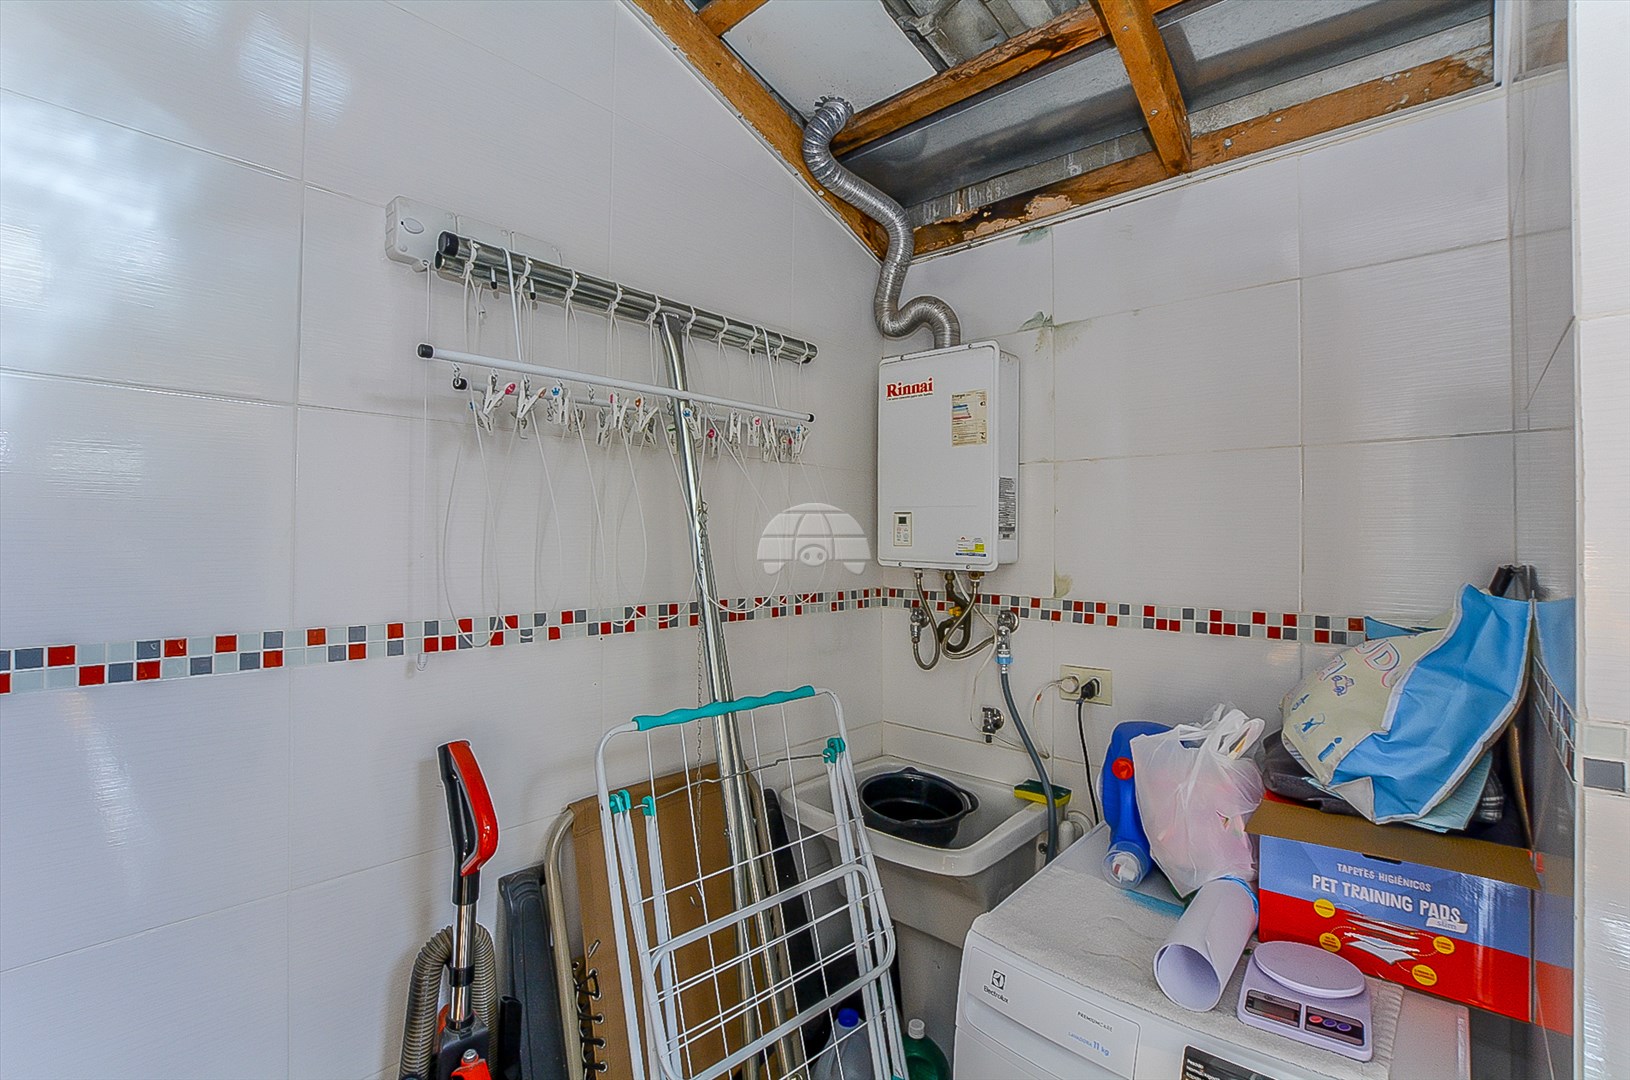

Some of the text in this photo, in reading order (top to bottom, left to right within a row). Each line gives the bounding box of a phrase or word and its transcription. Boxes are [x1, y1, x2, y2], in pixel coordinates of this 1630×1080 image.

[886, 377, 933, 398] Rinnai
[1336, 863, 1432, 893] TAPETES HIGIÊNICOS
[1312, 874, 1461, 923] PET TRAINING PADS
[983, 985, 1009, 1004] Electrolux
[1093, 1040, 1100, 1051] 11
[1101, 1045, 1110, 1056] kg
